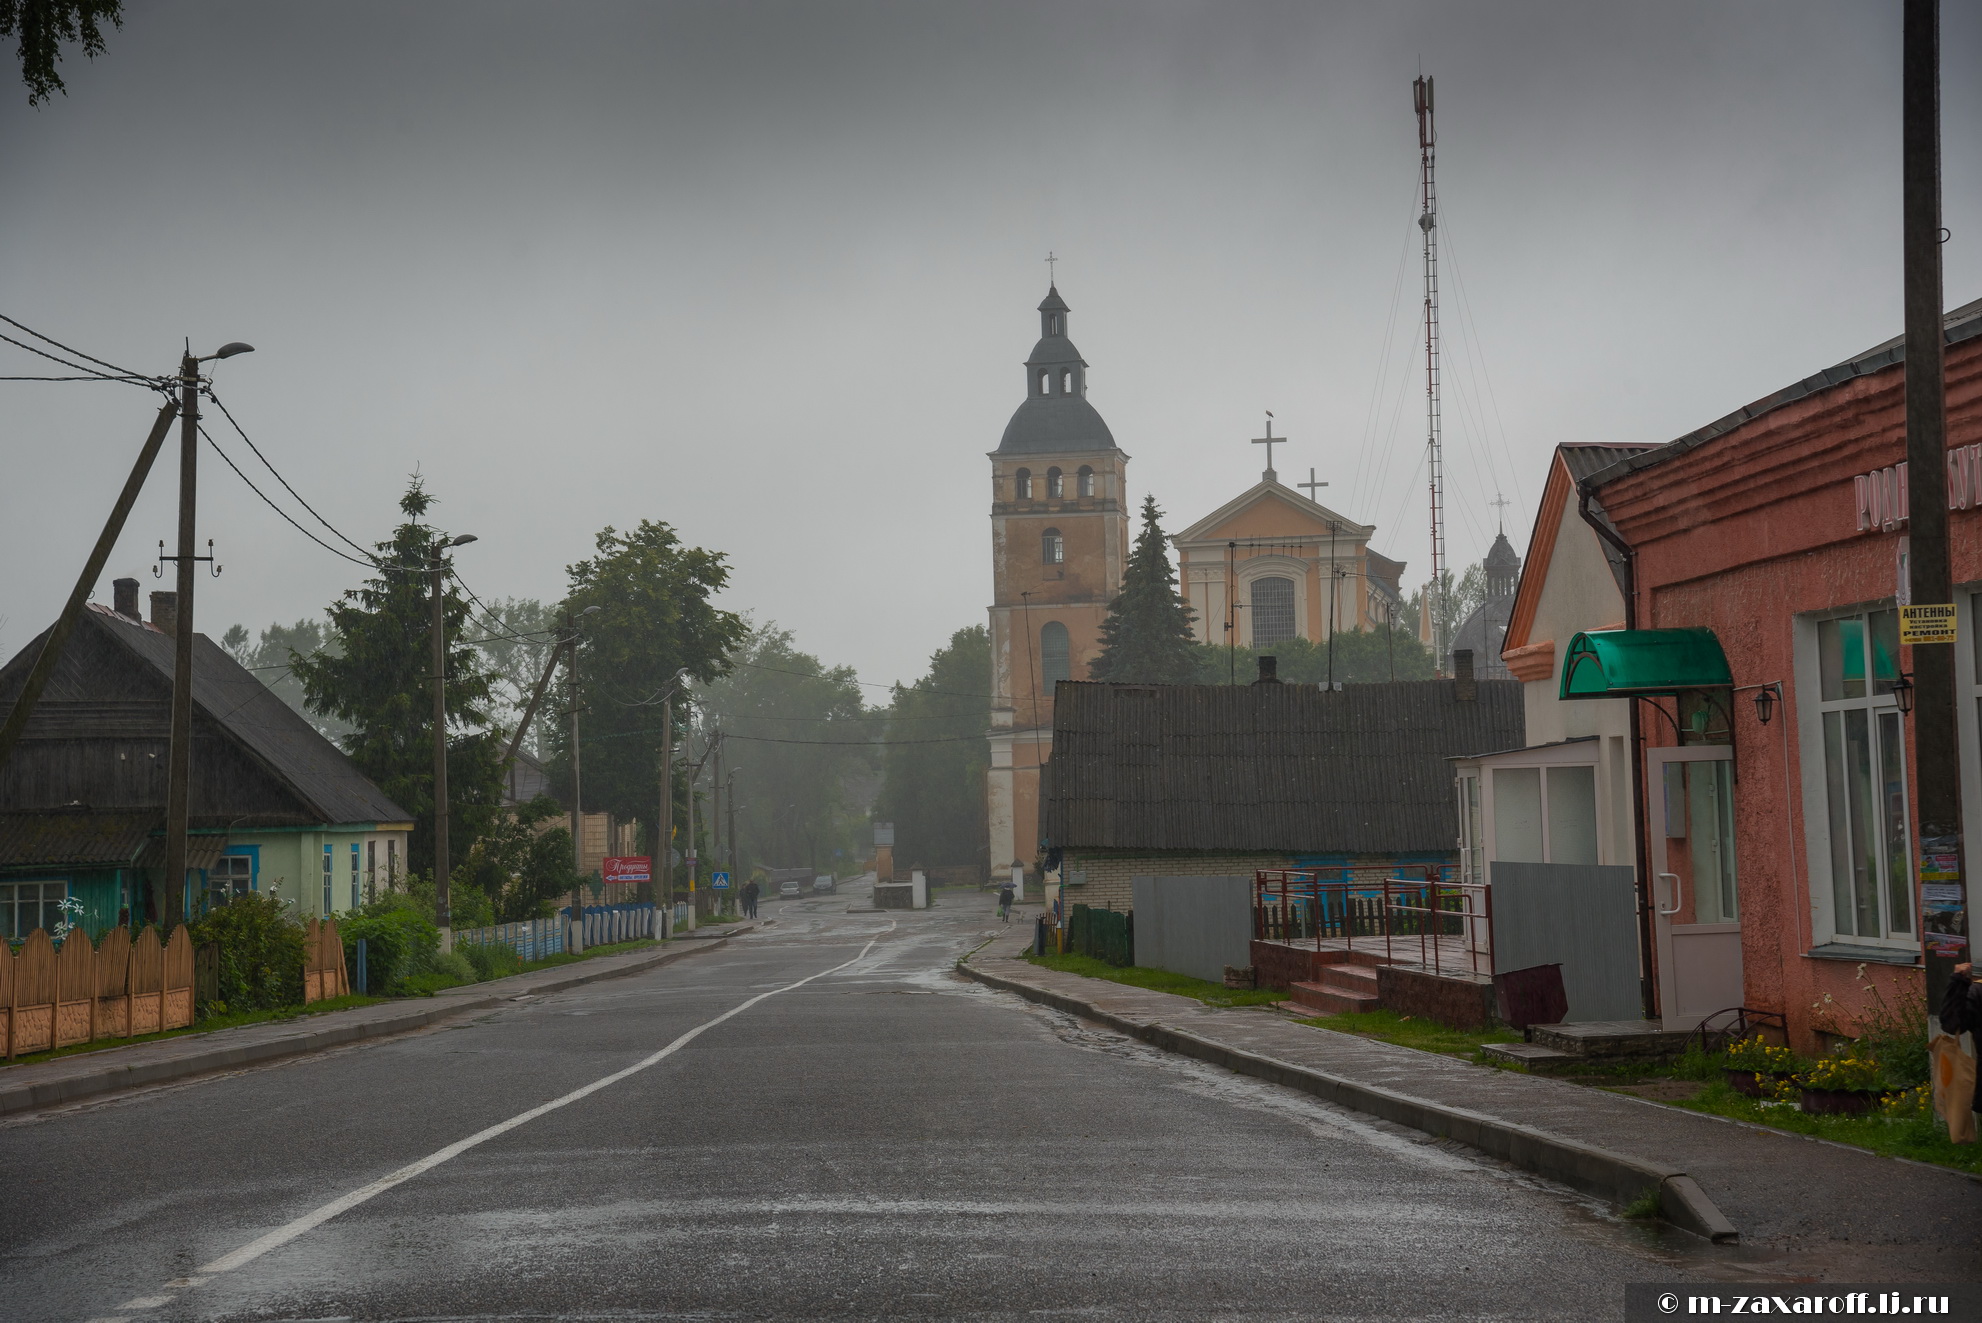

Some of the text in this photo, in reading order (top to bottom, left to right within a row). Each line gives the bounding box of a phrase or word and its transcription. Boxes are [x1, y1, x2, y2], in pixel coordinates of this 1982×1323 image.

[1854, 461, 1909, 533] РОДН
[1903, 606, 1955, 619] АНТЕННЫ
[1903, 628, 1957, 637] РЕМОНТ
